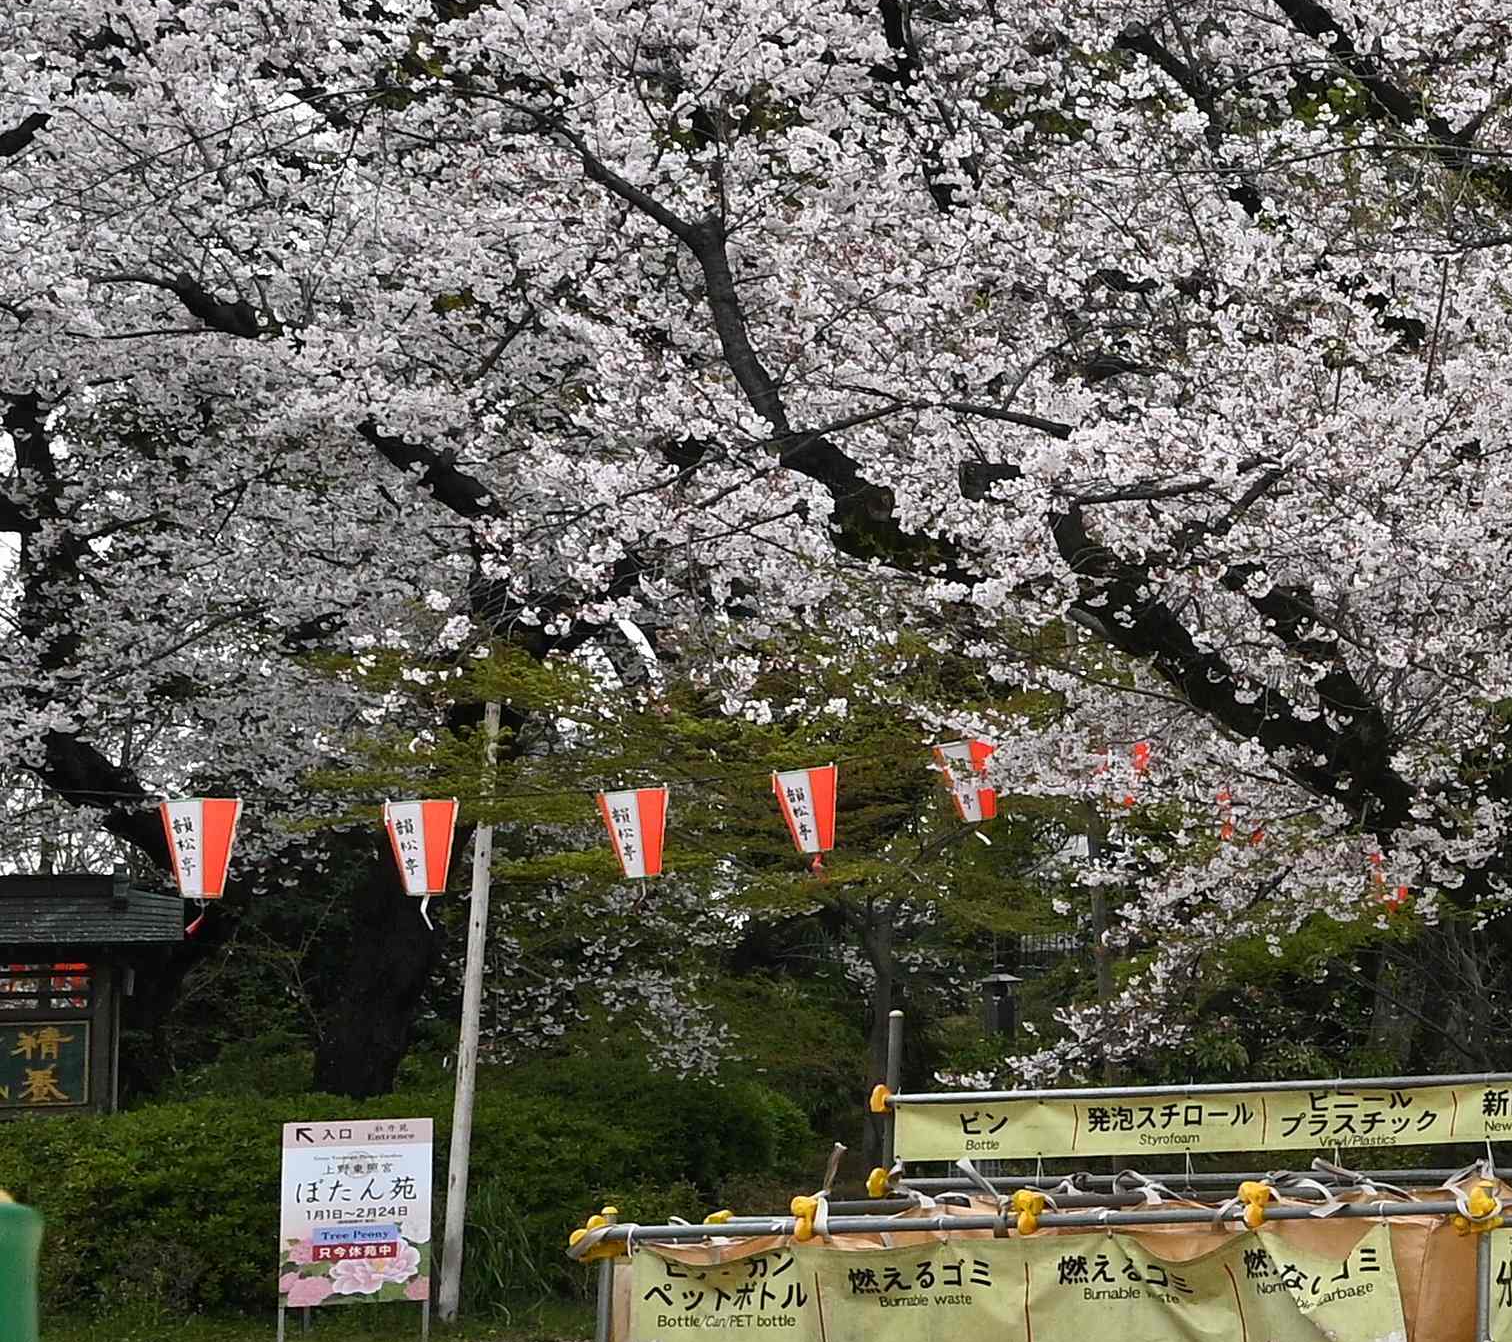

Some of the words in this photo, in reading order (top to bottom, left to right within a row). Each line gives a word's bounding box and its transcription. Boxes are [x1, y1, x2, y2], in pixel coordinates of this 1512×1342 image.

[959, 1110, 1009, 1136] ビン
[1087, 1102, 1255, 1133] 発泡スチロール
[1281, 1110, 1438, 1138] プラスチック
[322, 1128, 352, 1141] 入口
[1138, 1132, 1201, 1147] Styrofoam
[965, 1138, 1000, 1151] Bottle
[847, 1259, 993, 1295] 燃えるゴミ
[643, 1281, 808, 1312] ペットボトル
[933, 1293, 973, 1306] waste
[1083, 1286, 1141, 1301] Burnable
[756, 1314, 797, 1328] bottle
